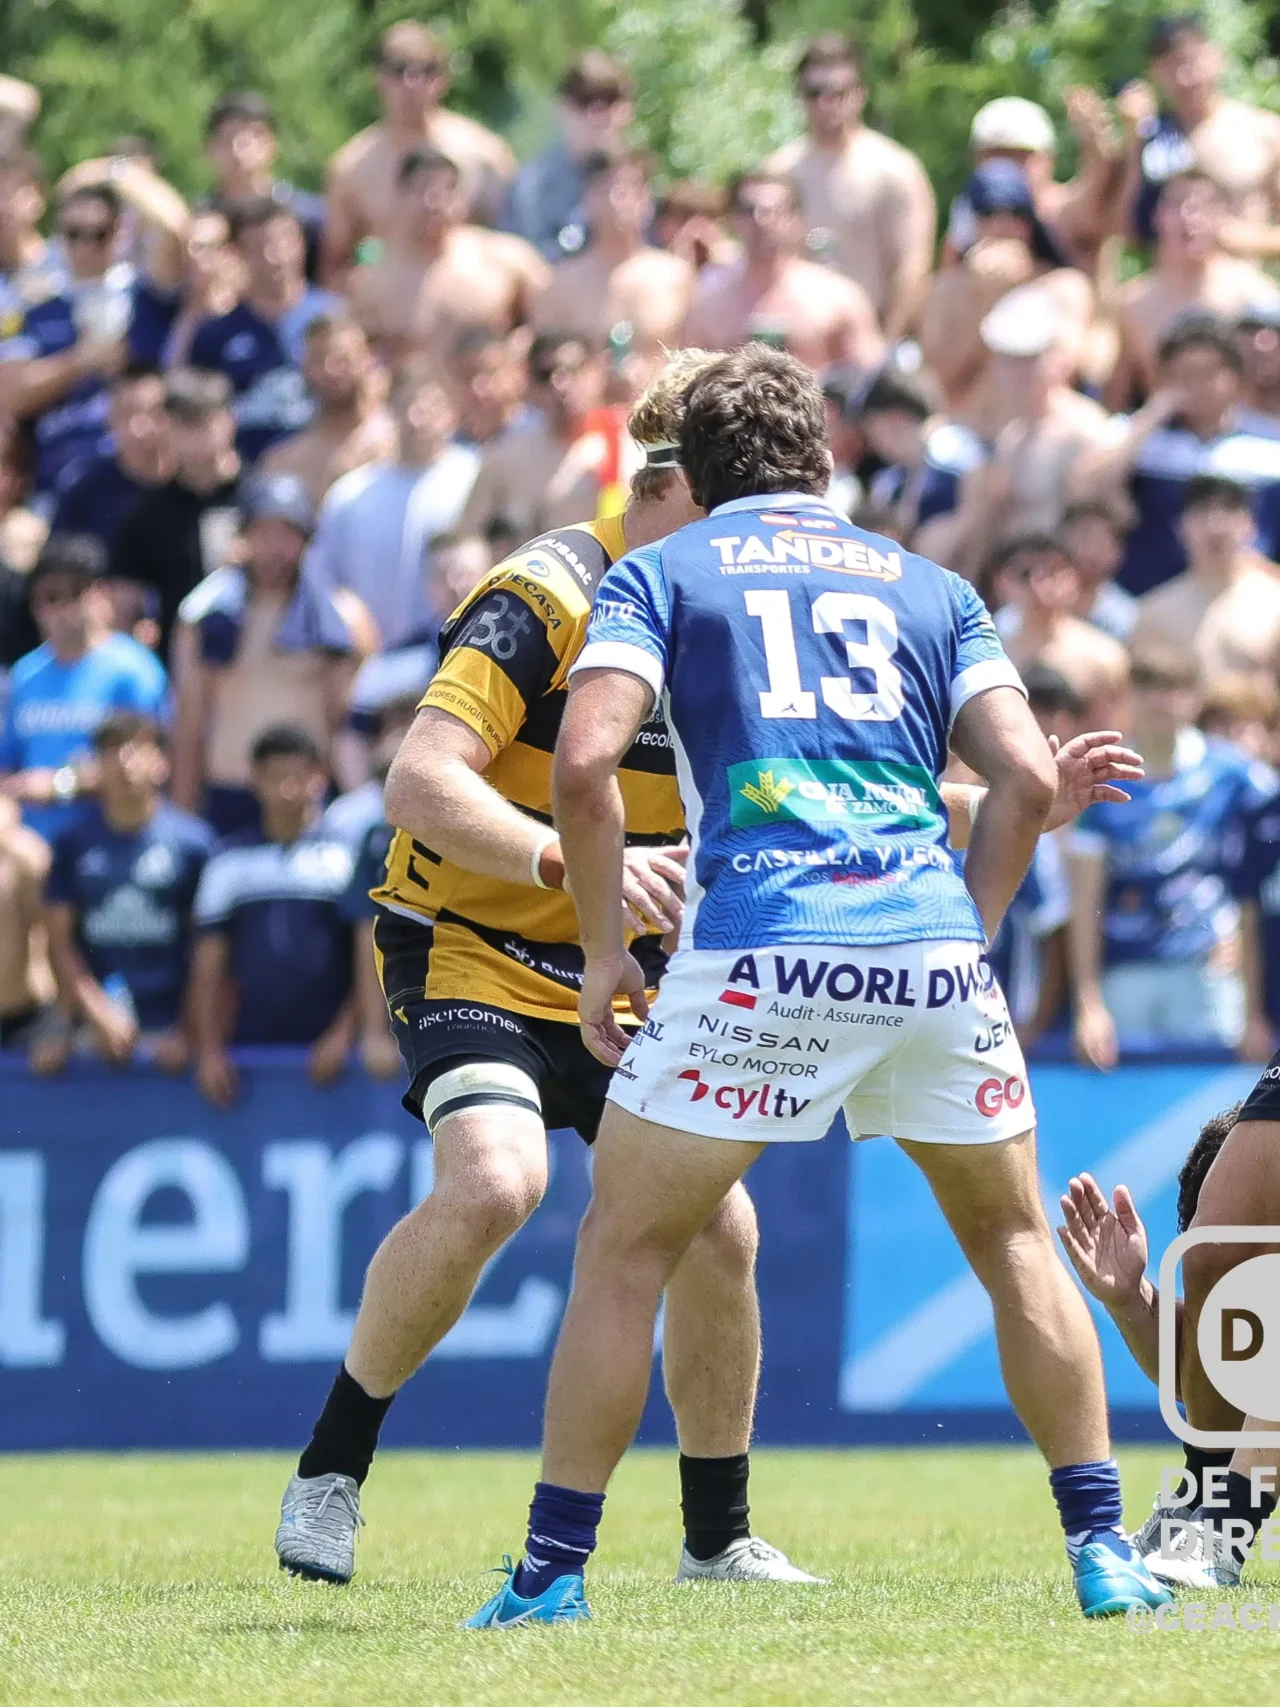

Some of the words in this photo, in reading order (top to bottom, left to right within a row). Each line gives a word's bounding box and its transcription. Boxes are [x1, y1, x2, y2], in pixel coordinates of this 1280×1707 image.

[710, 534, 902, 578] TANDEN
[718, 564, 811, 576] TRANSPORTES
[743, 589, 905, 722] 13
[457, 698, 488, 725] RUGBY
[732, 846, 862, 874] CASTILLA
[874, 847, 892, 870] Y
[698, 1013, 830, 1054] NISSAN
[766, 1001, 813, 1020] Audit
[823, 1005, 904, 1028] Assurance
[689, 1042, 739, 1068] EYLO
[742, 1055, 819, 1080] MOTOR
[714, 1082, 812, 1121] cyltv
